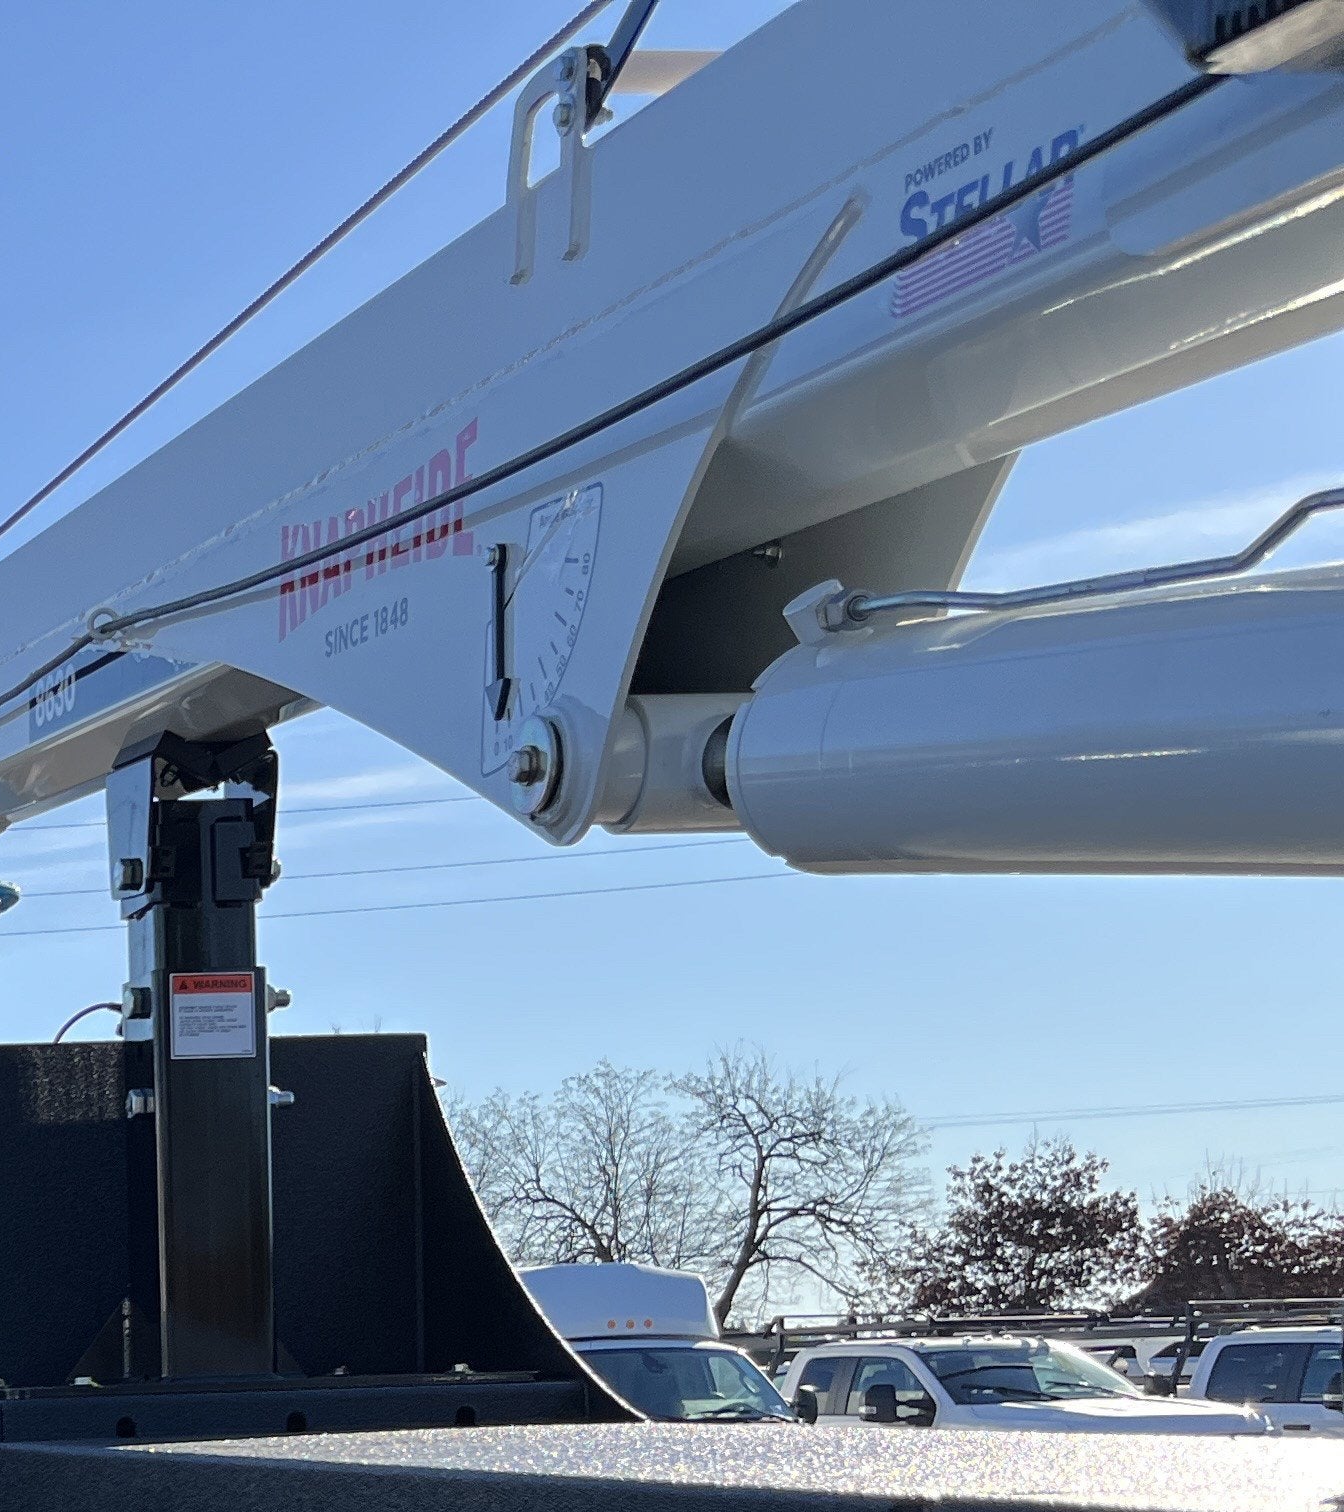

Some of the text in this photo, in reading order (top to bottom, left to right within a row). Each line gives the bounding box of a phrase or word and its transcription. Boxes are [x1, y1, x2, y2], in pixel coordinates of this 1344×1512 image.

[905, 127, 994, 193] POWERED BY
[279, 416, 478, 643] KNAPHEIDE
[325, 597, 409, 658] SINCE 1848
[193, 979, 247, 989] WARNING
